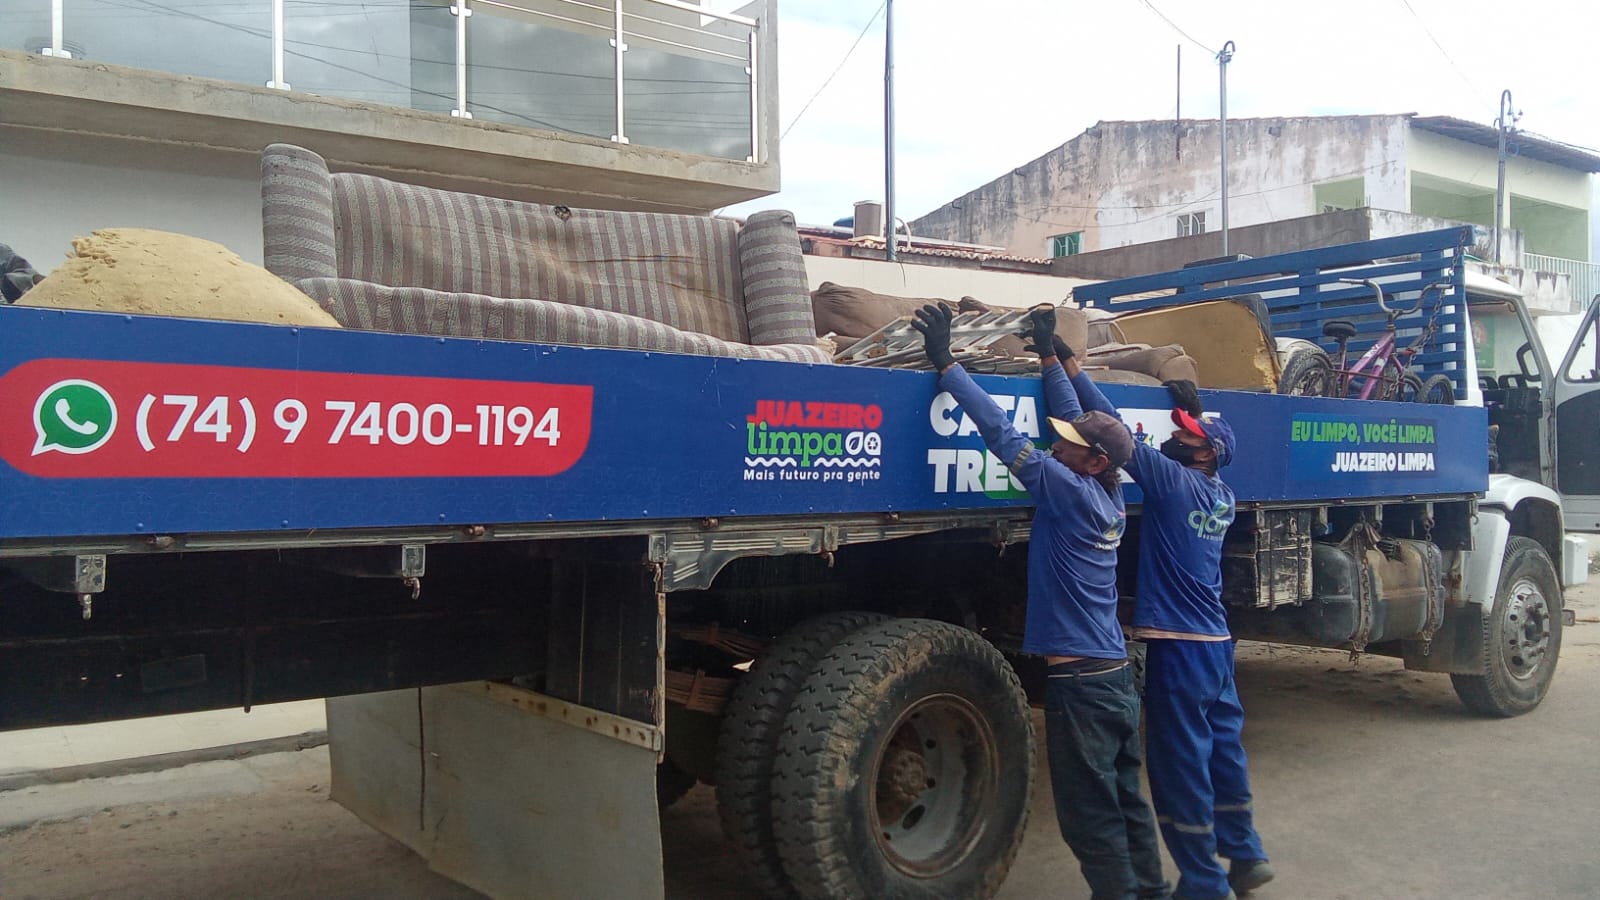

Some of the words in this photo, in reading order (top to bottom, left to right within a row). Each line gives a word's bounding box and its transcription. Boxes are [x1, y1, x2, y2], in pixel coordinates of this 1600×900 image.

[136, 394, 256, 452] (74)
[273, 399, 309, 444] 9
[325, 400, 562, 446] 7400-1194
[746, 399, 884, 430] JUAZEIRO
[746, 421, 843, 467] limpa
[1291, 421, 1312, 442] EU
[1312, 422, 1361, 445] LIMPO,
[1363, 419, 1397, 443] VOCÊ
[1400, 424, 1435, 444] LIMPA
[743, 469, 775, 481] Mais
[780, 469, 820, 481] futuro
[823, 471, 843, 482] pra
[847, 470, 881, 482] gente
[1331, 452, 1397, 473] JUAZEIRO
[1398, 452, 1435, 472] LIMPA
